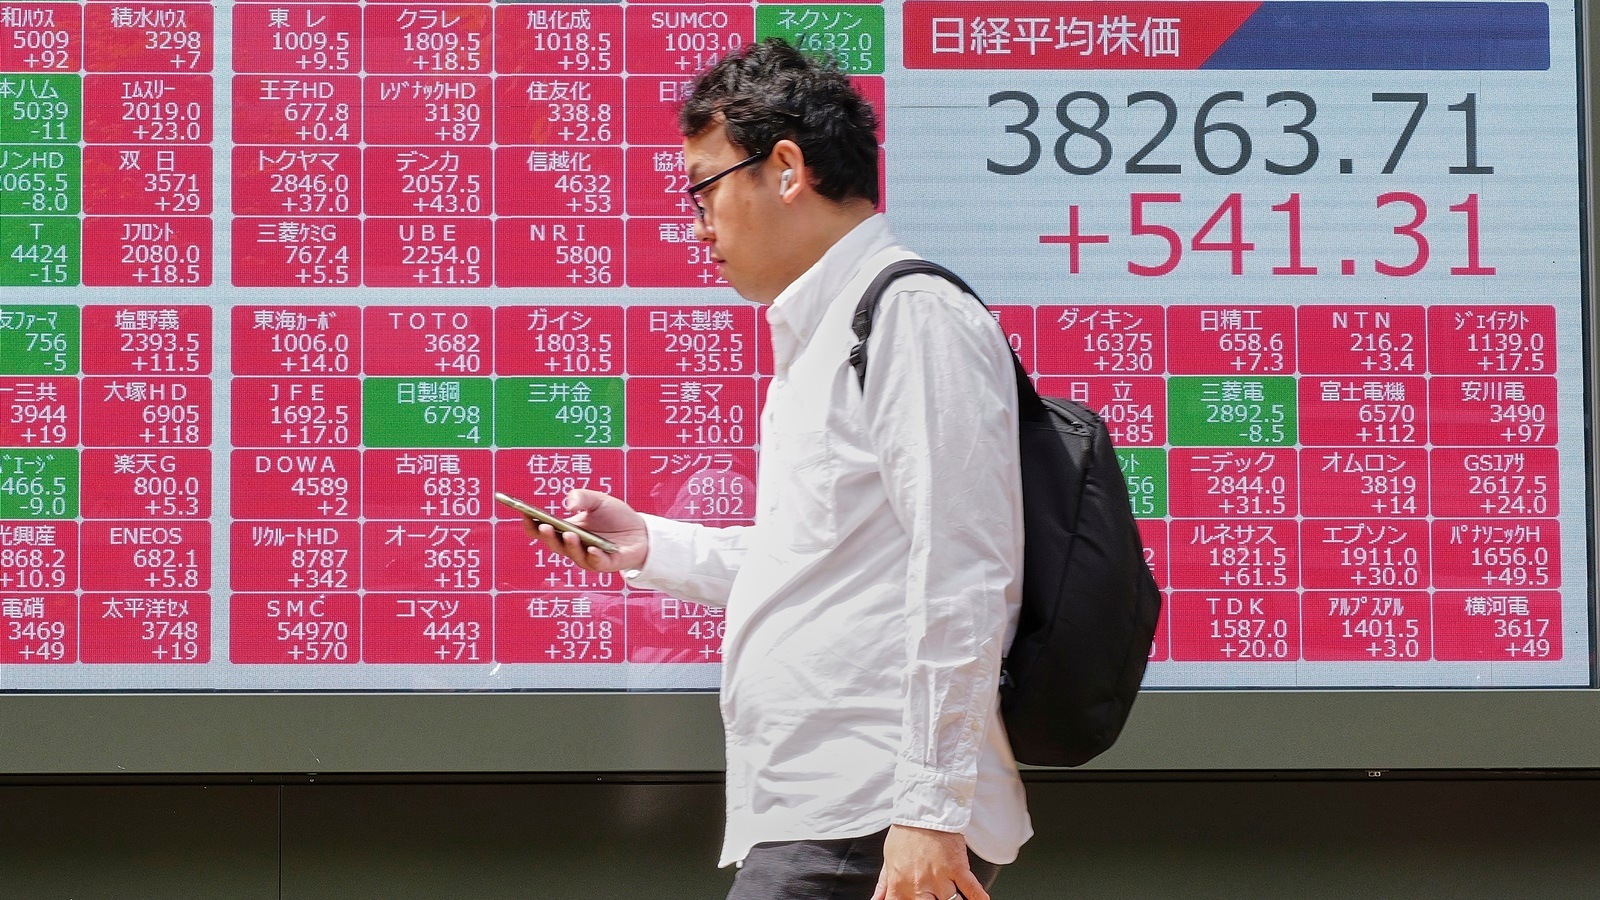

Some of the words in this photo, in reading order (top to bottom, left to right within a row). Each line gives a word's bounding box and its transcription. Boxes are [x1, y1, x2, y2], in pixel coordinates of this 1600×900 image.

[397, 9, 460, 29] クラレ
[527, 9, 591, 29] 旭化成
[652, 12, 728, 28] SUMCO
[777, 9, 862, 30] ネクソン
[14, 31, 69, 48] 5009
[146, 31, 200, 49] 3298
[273, 32, 348, 50] 1009.5
[405, 33, 480, 51] 1809.5
[535, 33, 610, 51] 1018.5
[931, 16, 1182, 57] 日経平均株価
[24, 50, 68, 68] +92
[296, 52, 349, 70] +9.5
[414, 52, 480, 70] +18.5
[558, 52, 611, 70] +9.5
[260, 80, 334, 100] 王子HD
[527, 80, 591, 101] 住友化
[14, 102, 68, 120] 5039
[123, 102, 200, 120] 2019.0
[285, 103, 348, 121] 677.8
[425, 103, 480, 122] 3130
[548, 103, 611, 122] 338.8
[31, 122, 67, 139] -11
[133, 122, 200, 140] +23.0
[296, 123, 349, 141] +0.4
[558, 123, 611, 141] +2.6
[986, 90, 1494, 175] 38263.71
[260, 150, 339, 171] トクヤマ
[396, 151, 459, 172] デンカ
[527, 151, 591, 171] 信越化
[145, 174, 199, 192] 3571
[271, 174, 348, 192] 2846.0
[402, 175, 479, 193] 2057.5
[555, 175, 611, 193] 4632
[23, 193, 67, 211] -8.0
[282, 194, 348, 212] +37.0
[413, 194, 480, 212] +43.0
[1038, 192, 1496, 277] +541.31
[11, 245, 67, 263] 4424
[122, 245, 199, 263] 2080.0
[285, 246, 349, 264] 767.4
[402, 246, 480, 264] 2254.0
[557, 246, 611, 264] 5800
[31, 264, 67, 283] -15
[133, 265, 199, 283] +18.5
[413, 266, 480, 284] +11.5
[567, 265, 611, 284] +36
[115, 309, 179, 330] 塩野義
[528, 309, 591, 331] ガイシ
[650, 310, 733, 332] 日本製鉄
[1058, 308, 1142, 330] ダイキン
[1201, 309, 1262, 331] 日精工
[26, 333, 66, 351] 756
[121, 333, 199, 351] 2393.5
[272, 334, 348, 352] 1006.0
[425, 334, 479, 352] 3682
[536, 334, 611, 352] 1803.5
[665, 334, 742, 352] 2902.5
[1085, 333, 1152, 351] 16375
[1220, 333, 1283, 351] 658.6
[1351, 333, 1413, 351] 216.2
[1468, 333, 1543, 351] 1139.0
[132, 354, 199, 371] +11.5
[281, 354, 348, 372] +14.0
[435, 354, 480, 372] +40
[545, 354, 611, 372] +10.5
[676, 354, 742, 372] +35.5
[1094, 353, 1152, 371] +230
[1361, 353, 1414, 371] +3.4
[1478, 353, 1544, 371] +17.5
[397, 381, 460, 403] 日製鋼
[528, 381, 591, 402] 三井金
[660, 382, 723, 402] 三菱マ
[1201, 381, 1264, 401] 三菱電
[1321, 381, 1405, 401] 富士電機
[1462, 381, 1525, 401] 安川電
[11, 405, 66, 423] 3944
[143, 405, 199, 423] 6905
[272, 406, 348, 424] 1692.5
[424, 406, 480, 424] 6798
[555, 405, 611, 424] 4903
[666, 405, 743, 423] 2254.0
[1207, 405, 1284, 423] 2892.5
[1359, 404, 1414, 422] 6570
[1491, 404, 1545, 422] 3490
[21, 425, 66, 443] +19
[140, 426, 199, 443] +118
[281, 426, 348, 444] +17.0
[575, 426, 611, 443] -23
[677, 426, 743, 443] +10.0
[1240, 424, 1284, 442] -8.5
[1356, 424, 1415, 442] +112
[1501, 424, 1545, 442] +97
[114, 454, 175, 473] 楽天G
[396, 454, 460, 474] 古河電
[527, 453, 592, 474] 住友電
[651, 453, 732, 476] フジクラ
[1191, 452, 1275, 473] ニデック
[1322, 452, 1405, 472] オムロン
[134, 477, 198, 495] 800.0
[291, 477, 348, 496] 4589
[424, 477, 480, 496] 6833
[686, 476, 743, 495] 6816
[1208, 476, 1285, 494] 2844.0
[1361, 476, 1416, 494] 3819
[1469, 476, 1546, 494] 2617.5
[20, 497, 65, 515] -9.0
[145, 497, 198, 515] +5.3
[421, 497, 480, 516] +160
[684, 497, 743, 516] +302
[1219, 496, 1285, 514] +31.5
[1481, 496, 1546, 514] +24.0
[110, 528, 182, 544] ENEOS
[385, 525, 470, 546] オークマ
[1191, 524, 1276, 544] ルネサス
[1323, 523, 1407, 544] エプソン
[134, 549, 197, 567] 682.1
[292, 550, 348, 568] 8787
[425, 550, 480, 568] 3655
[1210, 547, 1286, 566] 1821.5
[1342, 547, 1417, 565] 1911.0
[1472, 547, 1548, 565] 1656.0
[145, 569, 198, 587] +5.8
[288, 570, 347, 588] +342
[435, 569, 480, 588] +15
[1220, 568, 1286, 586] +61.5
[1351, 568, 1417, 585] +30.0
[1482, 568, 1548, 585] +49.5
[397, 600, 459, 618] コマツ
[528, 596, 592, 617] 住友重
[1465, 596, 1529, 616] 横河電
[9, 622, 64, 639] 3469
[142, 622, 198, 640] 3748
[278, 622, 347, 640] 54970
[423, 622, 479, 640] 4443
[557, 621, 612, 639] 3018
[1211, 620, 1287, 638] 1587.0
[1343, 619, 1418, 637] 1401.5
[1495, 619, 1549, 637] 3617
[19, 641, 65, 659] +49
[152, 641, 197, 660] +19
[288, 642, 347, 660] +570
[545, 641, 612, 659] +37.5
[1221, 639, 1287, 658] +20.0
[1366, 639, 1418, 657] +3.0
